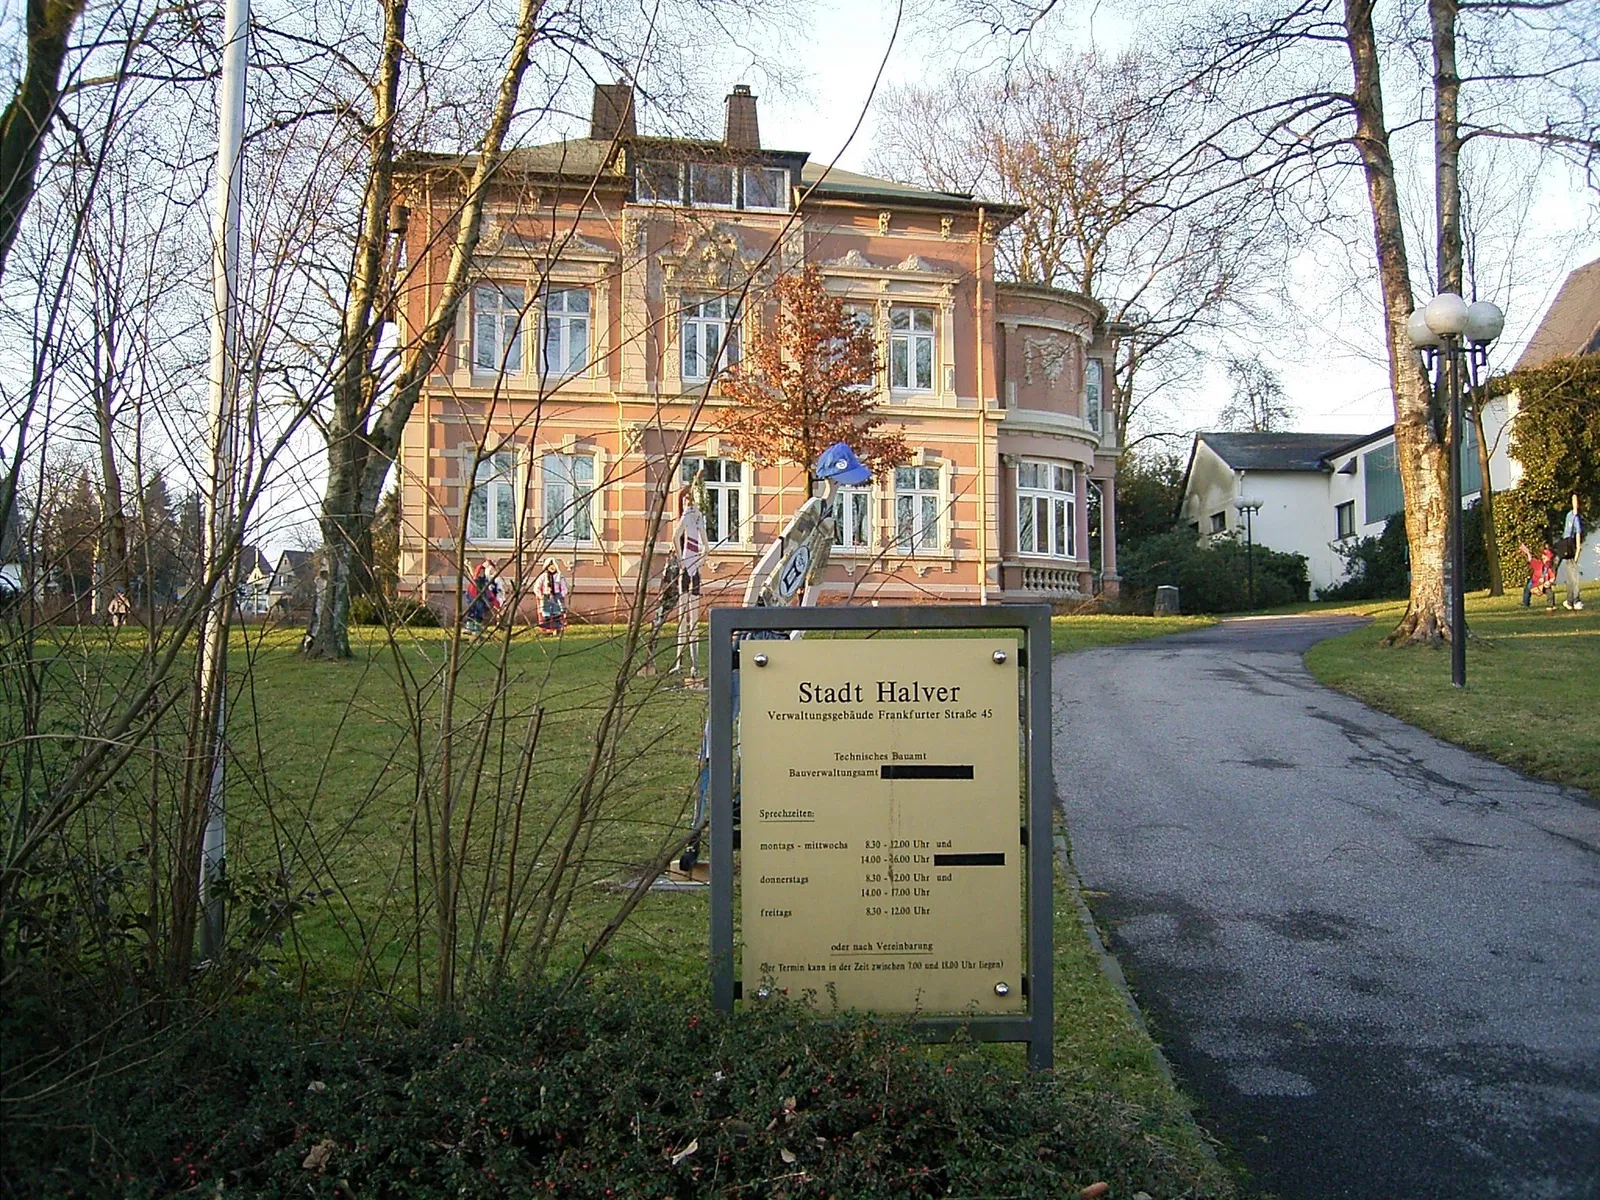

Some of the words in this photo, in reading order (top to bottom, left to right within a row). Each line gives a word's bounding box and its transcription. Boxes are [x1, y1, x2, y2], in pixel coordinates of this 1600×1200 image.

[798, 681, 864, 704] Stadt
[875, 680, 961, 703] Halver
[767, 709, 874, 722] Verwaltungsgebäude
[878, 709, 941, 722] Frankfurter
[944, 708, 977, 720] Straße
[981, 708, 993, 719] 45
[833, 752, 889, 762] Technisches
[891, 751, 927, 761] Bauamt
[788, 768, 879, 779] Bauverwaltungsamt
[759, 808, 815, 820] Sprechzeiten:
[760, 842, 795, 852] montags
[804, 840, 849, 850] mittwochs
[865, 839, 881, 850] 8.30
[890, 839, 911, 850] 12.00
[913, 839, 930, 849] Uhr
[935, 839, 953, 849] und
[861, 854, 882, 865] 14.00
[913, 854, 930, 864] Uhr
[759, 875, 809, 885] donnerstags
[865, 873, 882, 883] 8.30
[913, 872, 930, 883] Uhr
[936, 872, 953, 882] und
[861, 888, 882, 898] 14.00
[891, 886, 911, 898] 17.00
[913, 887, 930, 897] Uhr
[760, 907, 793, 919] freitags
[865, 906, 882, 917] 8.30
[891, 906, 911, 916] 12.00
[913, 906, 931, 916] Uhr
[830, 942, 850, 951] oder
[852, 941, 873, 951] nach
[875, 941, 934, 952] Vereinbarung
[777, 963, 805, 973] Termin
[807, 963, 826, 972] kann
[828, 962, 837, 972] in
[838, 962, 852, 972] der
[853, 961, 870, 972] Zeit
[871, 961, 906, 972] zwischen
[907, 961, 923, 970] 7.00
[924, 961, 939, 970] und
[961, 960, 976, 970] Uhr
